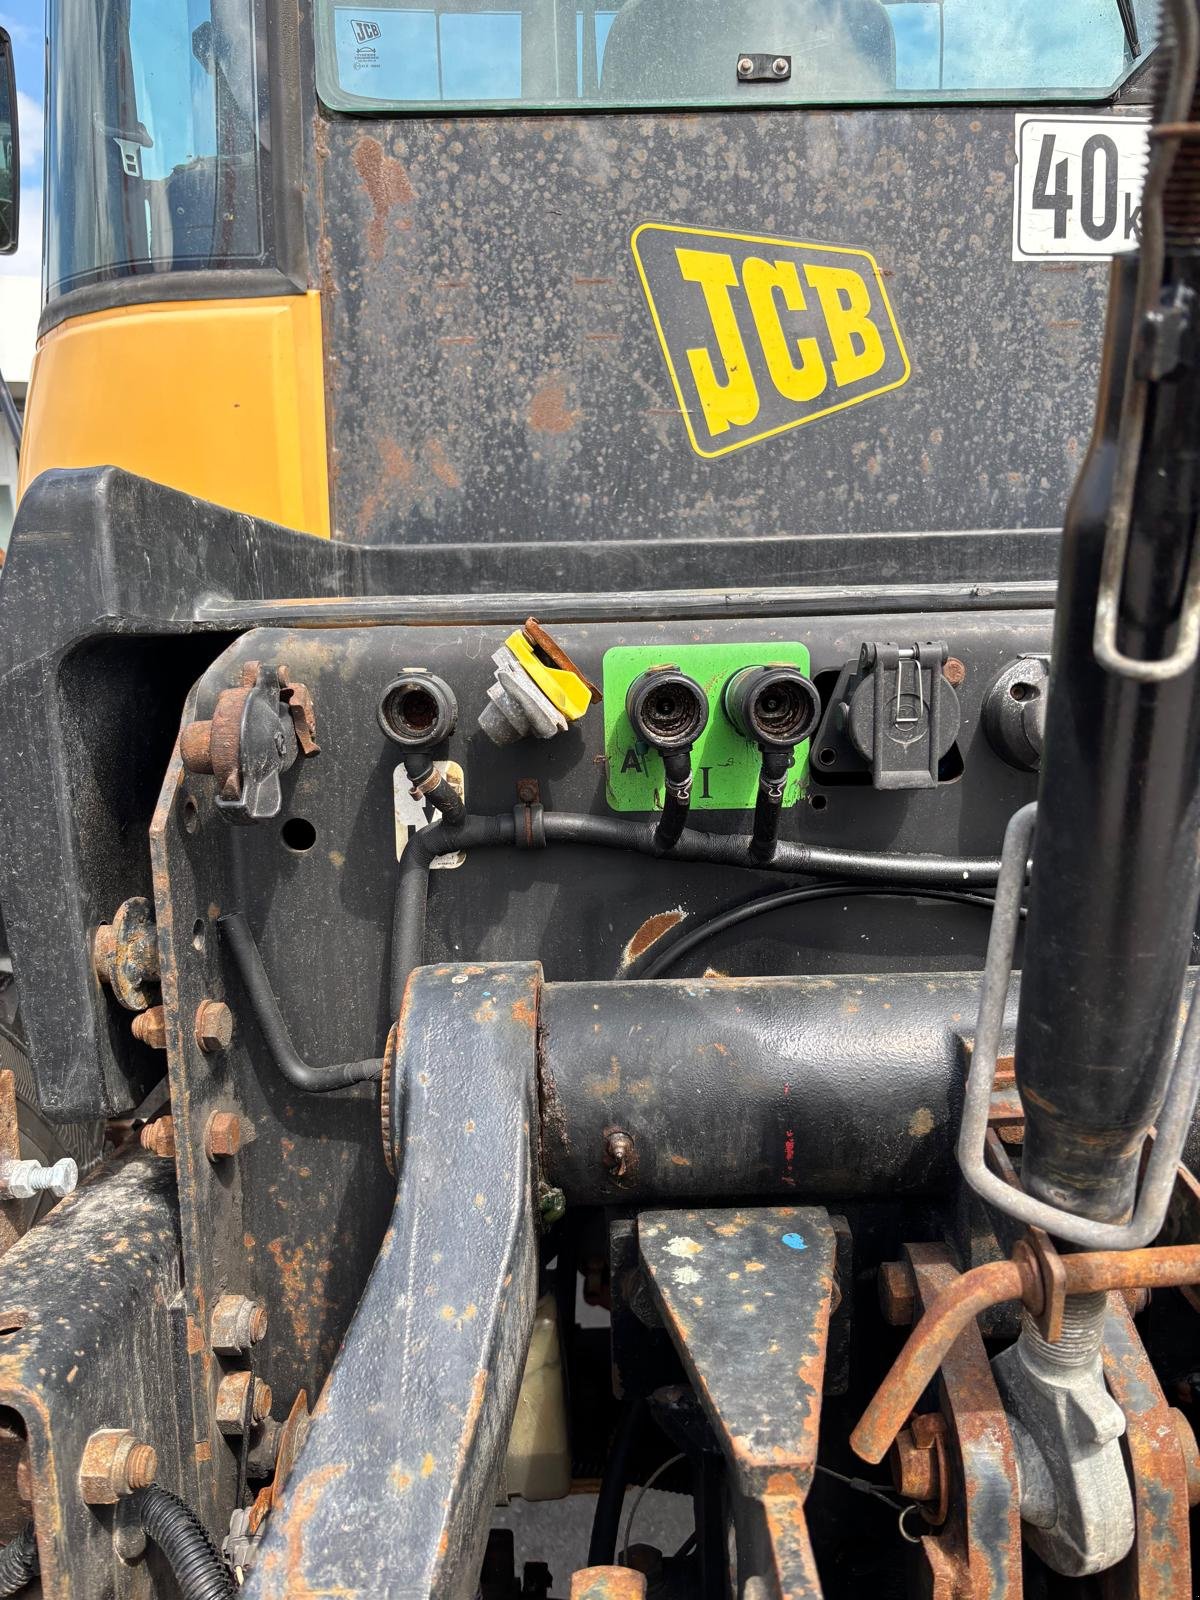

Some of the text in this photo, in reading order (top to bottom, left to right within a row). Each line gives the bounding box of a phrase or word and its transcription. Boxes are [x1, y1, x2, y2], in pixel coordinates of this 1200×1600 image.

[356, 22, 379, 41] JCB
[674, 247, 886, 437] JCB
[620, 748, 642, 773] A
